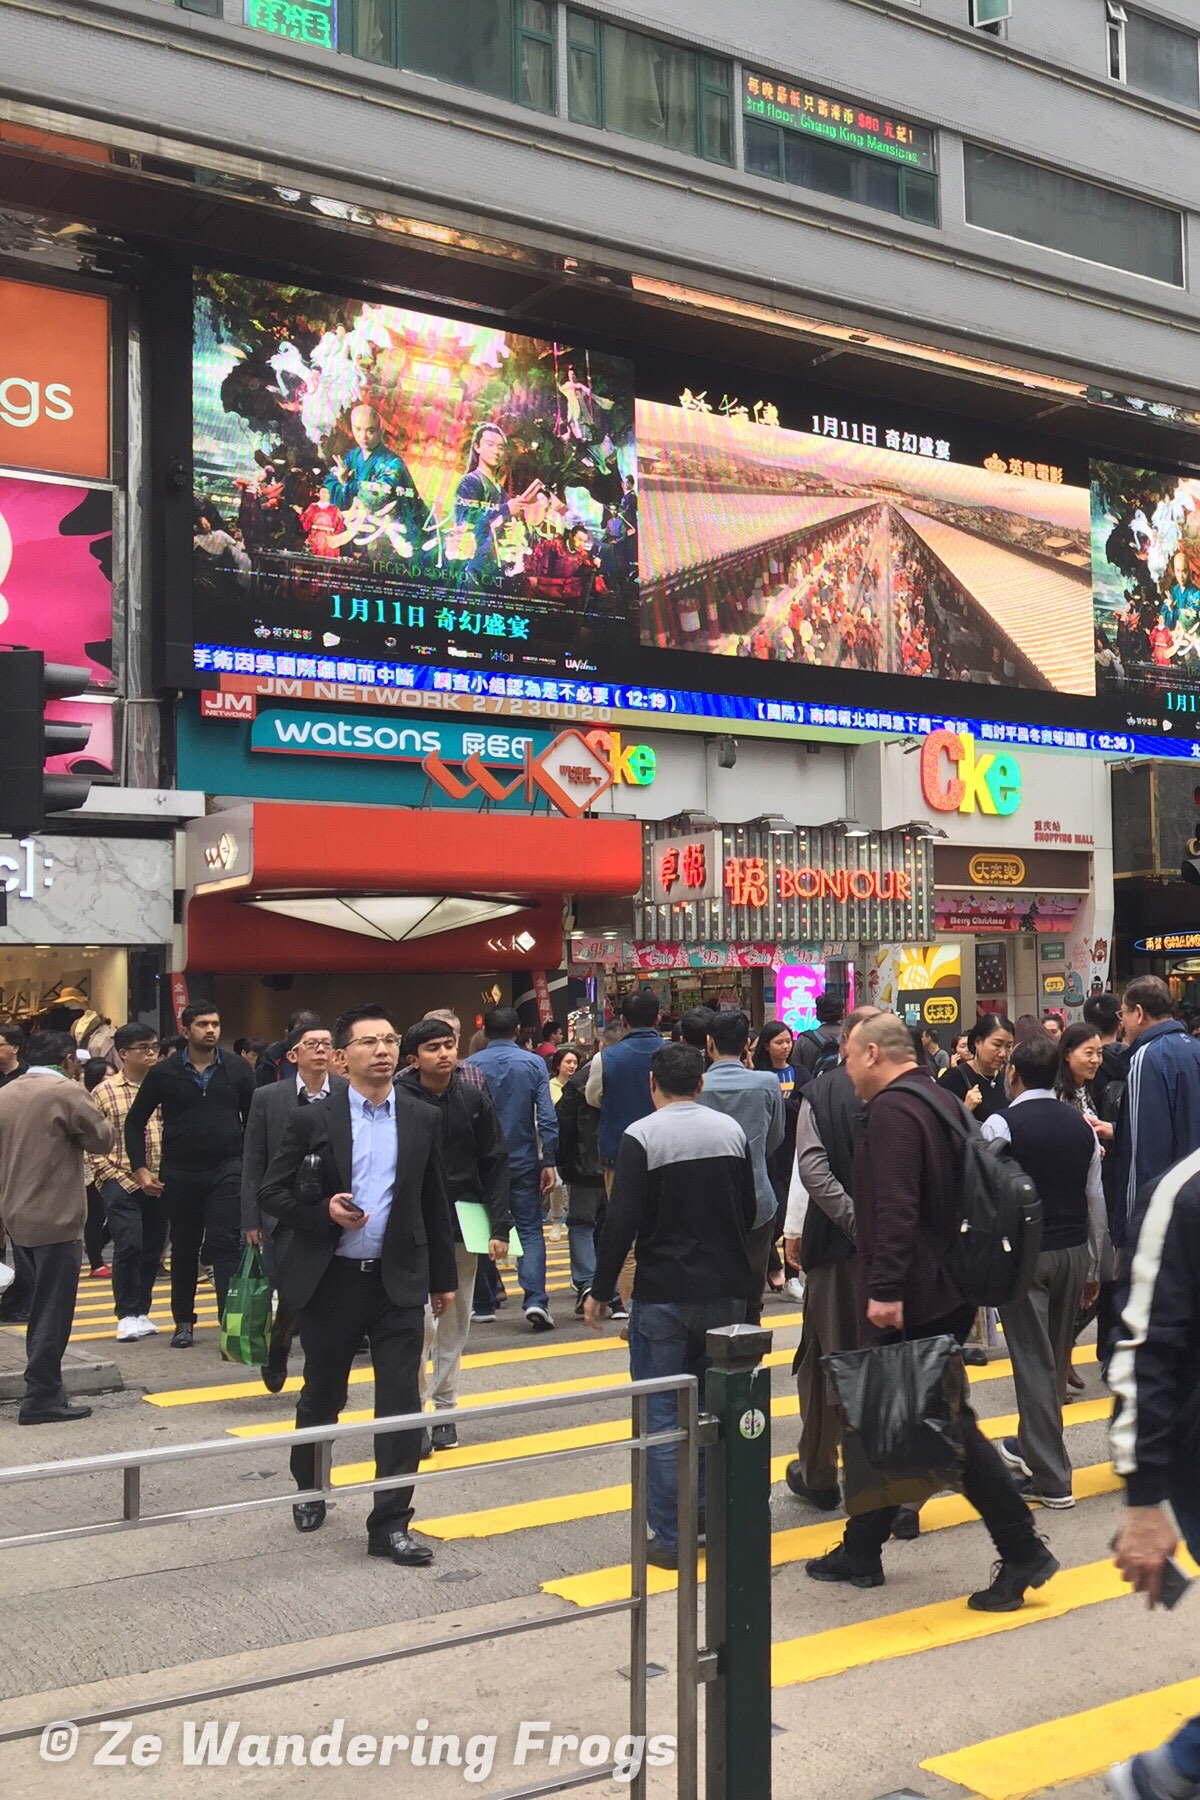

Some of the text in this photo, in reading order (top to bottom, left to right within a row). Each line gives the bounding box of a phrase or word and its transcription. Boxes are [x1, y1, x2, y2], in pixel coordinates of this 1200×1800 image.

[800, 115, 837, 139] Chung
[839, 125, 863, 148] King
[811, 414, 951, 461] 1月11日 奇幻盛宴
[330, 594, 532, 640] 1月11日 奇幻盛宴
[205, 693, 252, 711] JM
[205, 709, 252, 720] NETWORK
[256, 678, 612, 722] JM NETWORK 27230020
[274, 719, 442, 753] watsons
[920, 728, 1022, 816] Cke
[1034, 832, 1094, 845] SHOPPING MALL
[780, 866, 911, 904] BONJOUR
[951, 916, 1006, 926] Merry Christmas
